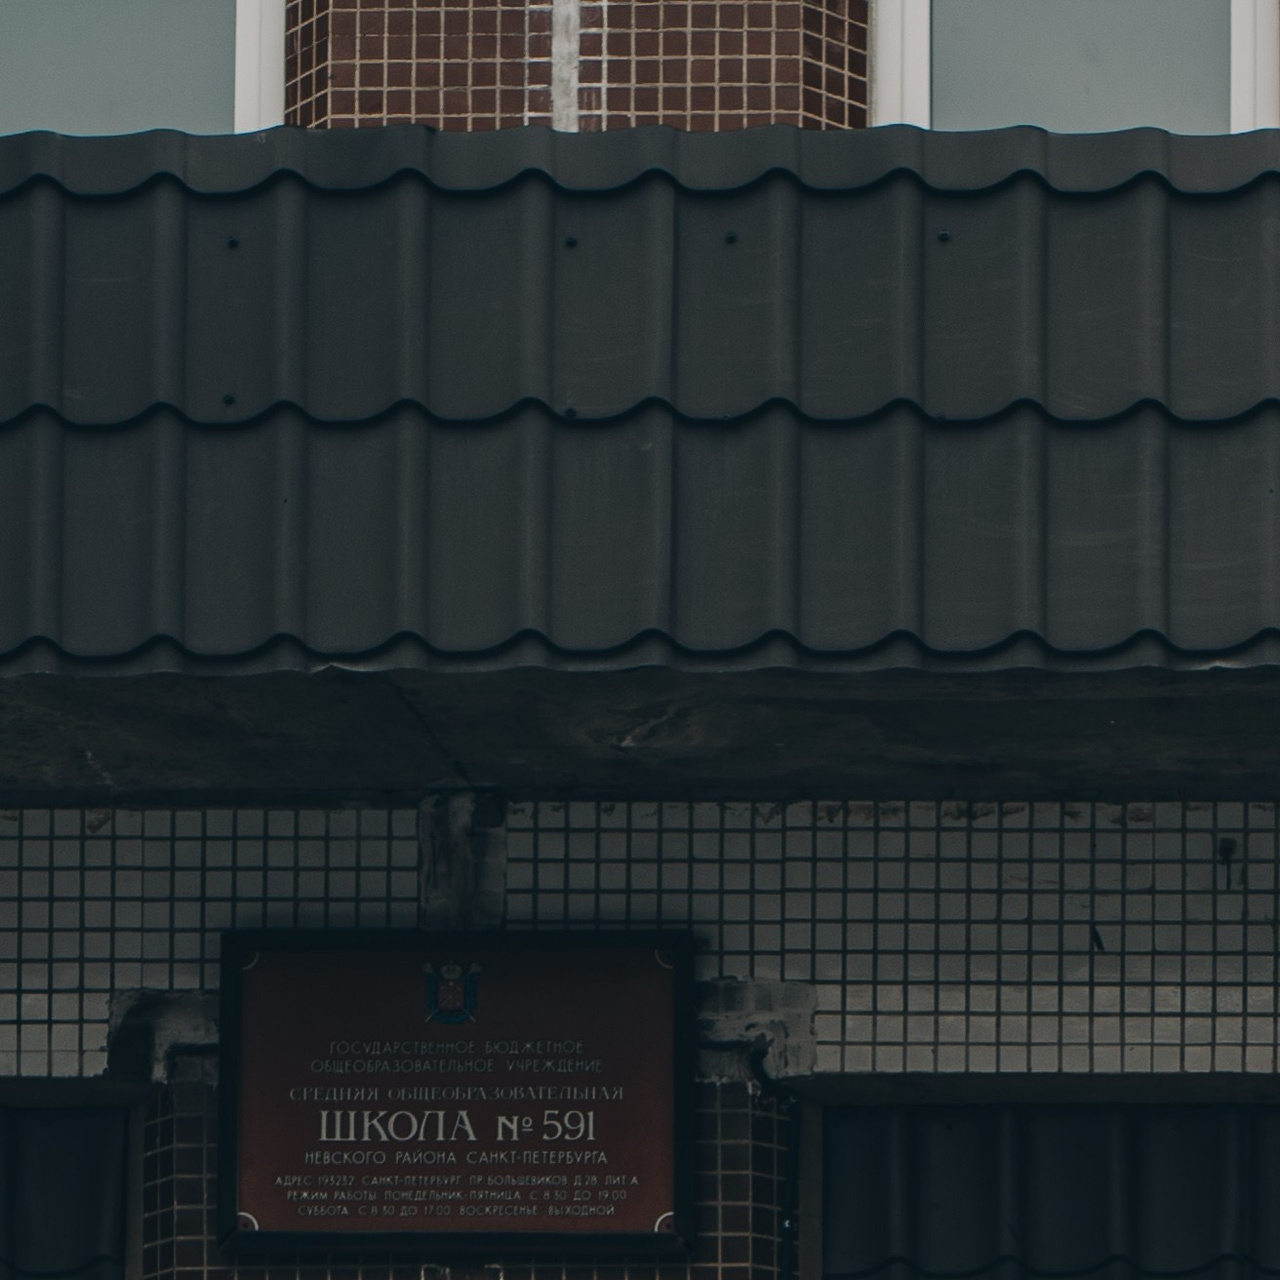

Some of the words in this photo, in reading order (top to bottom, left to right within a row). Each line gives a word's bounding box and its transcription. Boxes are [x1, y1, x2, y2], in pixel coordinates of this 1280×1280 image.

[330, 1041, 476, 1055] ГОСУДАРСТВЕННОЕ
[485, 1040, 584, 1054] БЮДЖЕТНОЕ
[311, 1059, 494, 1074] ОБЩЕОБРАЗОВАТЕЛЬНОЕ
[507, 1059, 603, 1073] УЧРЕЖДЕНИЕ
[290, 1086, 379, 1102] СРЕДНЯЯ
[388, 1086, 624, 1102] ОБЩЕОБРАЗОВАТЕЛЬНАЯ
[318, 1109, 478, 1142] ШКОЛА
[542, 1110, 596, 1142] 591
[304, 1150, 387, 1165] НЕВСКОГО
[395, 1149, 457, 1165] РАЙОНА
[466, 1150, 608, 1165] САНКТ-ПЕТЕРБУРГА
[287, 1190, 328, 1201] РЕЖИМ
[573, 1190, 592, 1201] ДО
[399, 1205, 418, 1217] ДО
[548, 1203, 615, 1217] ВЫХОДНОЙ
